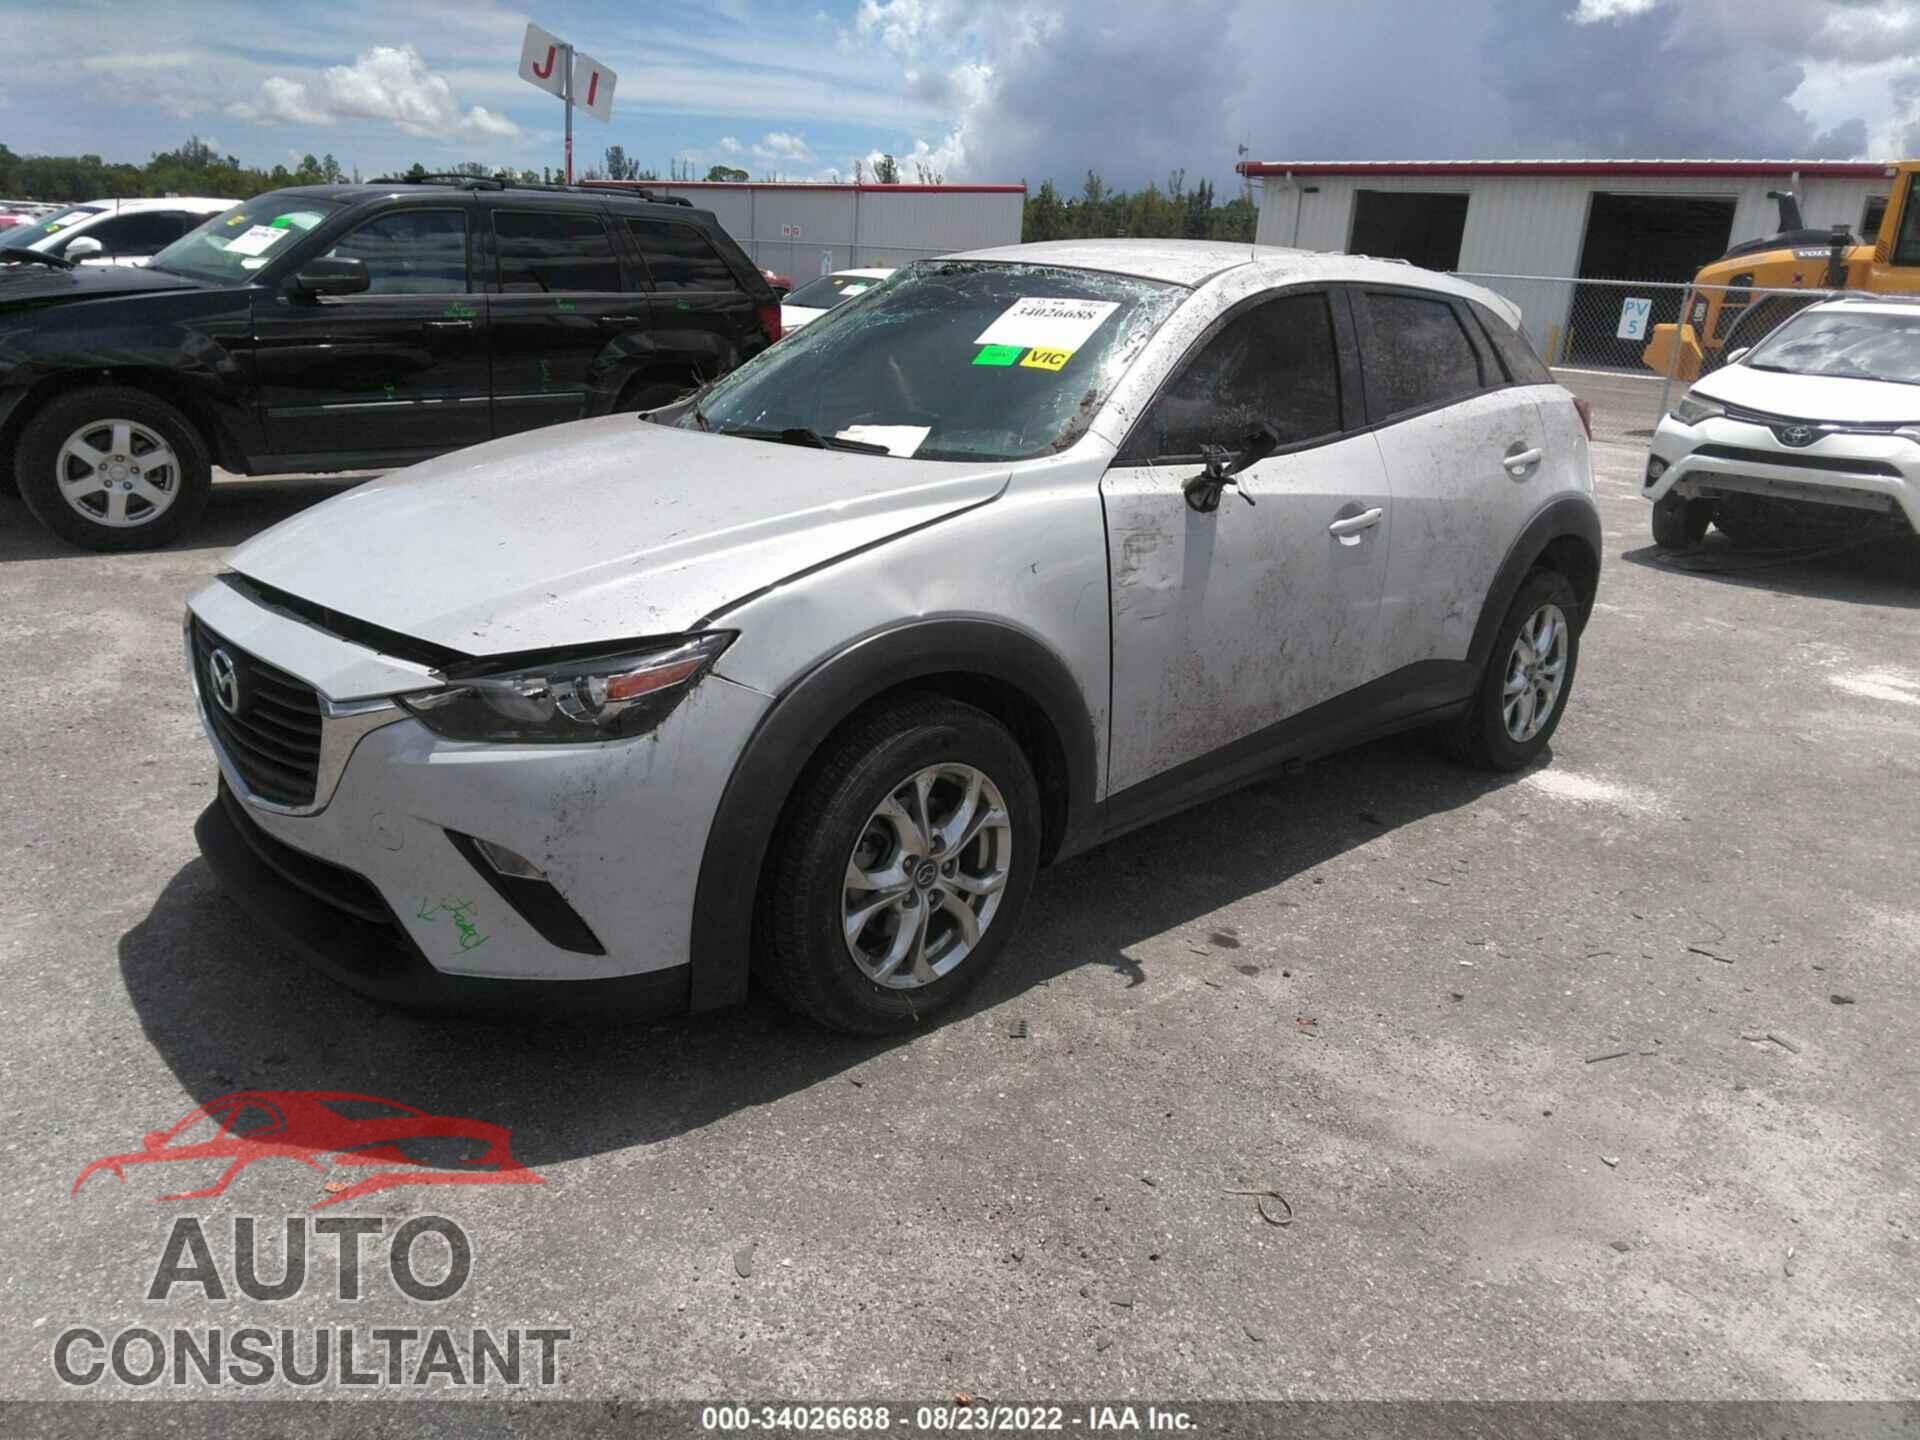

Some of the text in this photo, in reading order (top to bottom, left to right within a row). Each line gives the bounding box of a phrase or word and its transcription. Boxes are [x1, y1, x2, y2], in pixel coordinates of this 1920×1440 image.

[532, 45, 556, 79] J
[1013, 306, 1097, 321] 34026688
[1624, 300, 1649, 317] PV
[1627, 320, 1639, 335] 5
[1031, 350, 1066, 365] VIC
